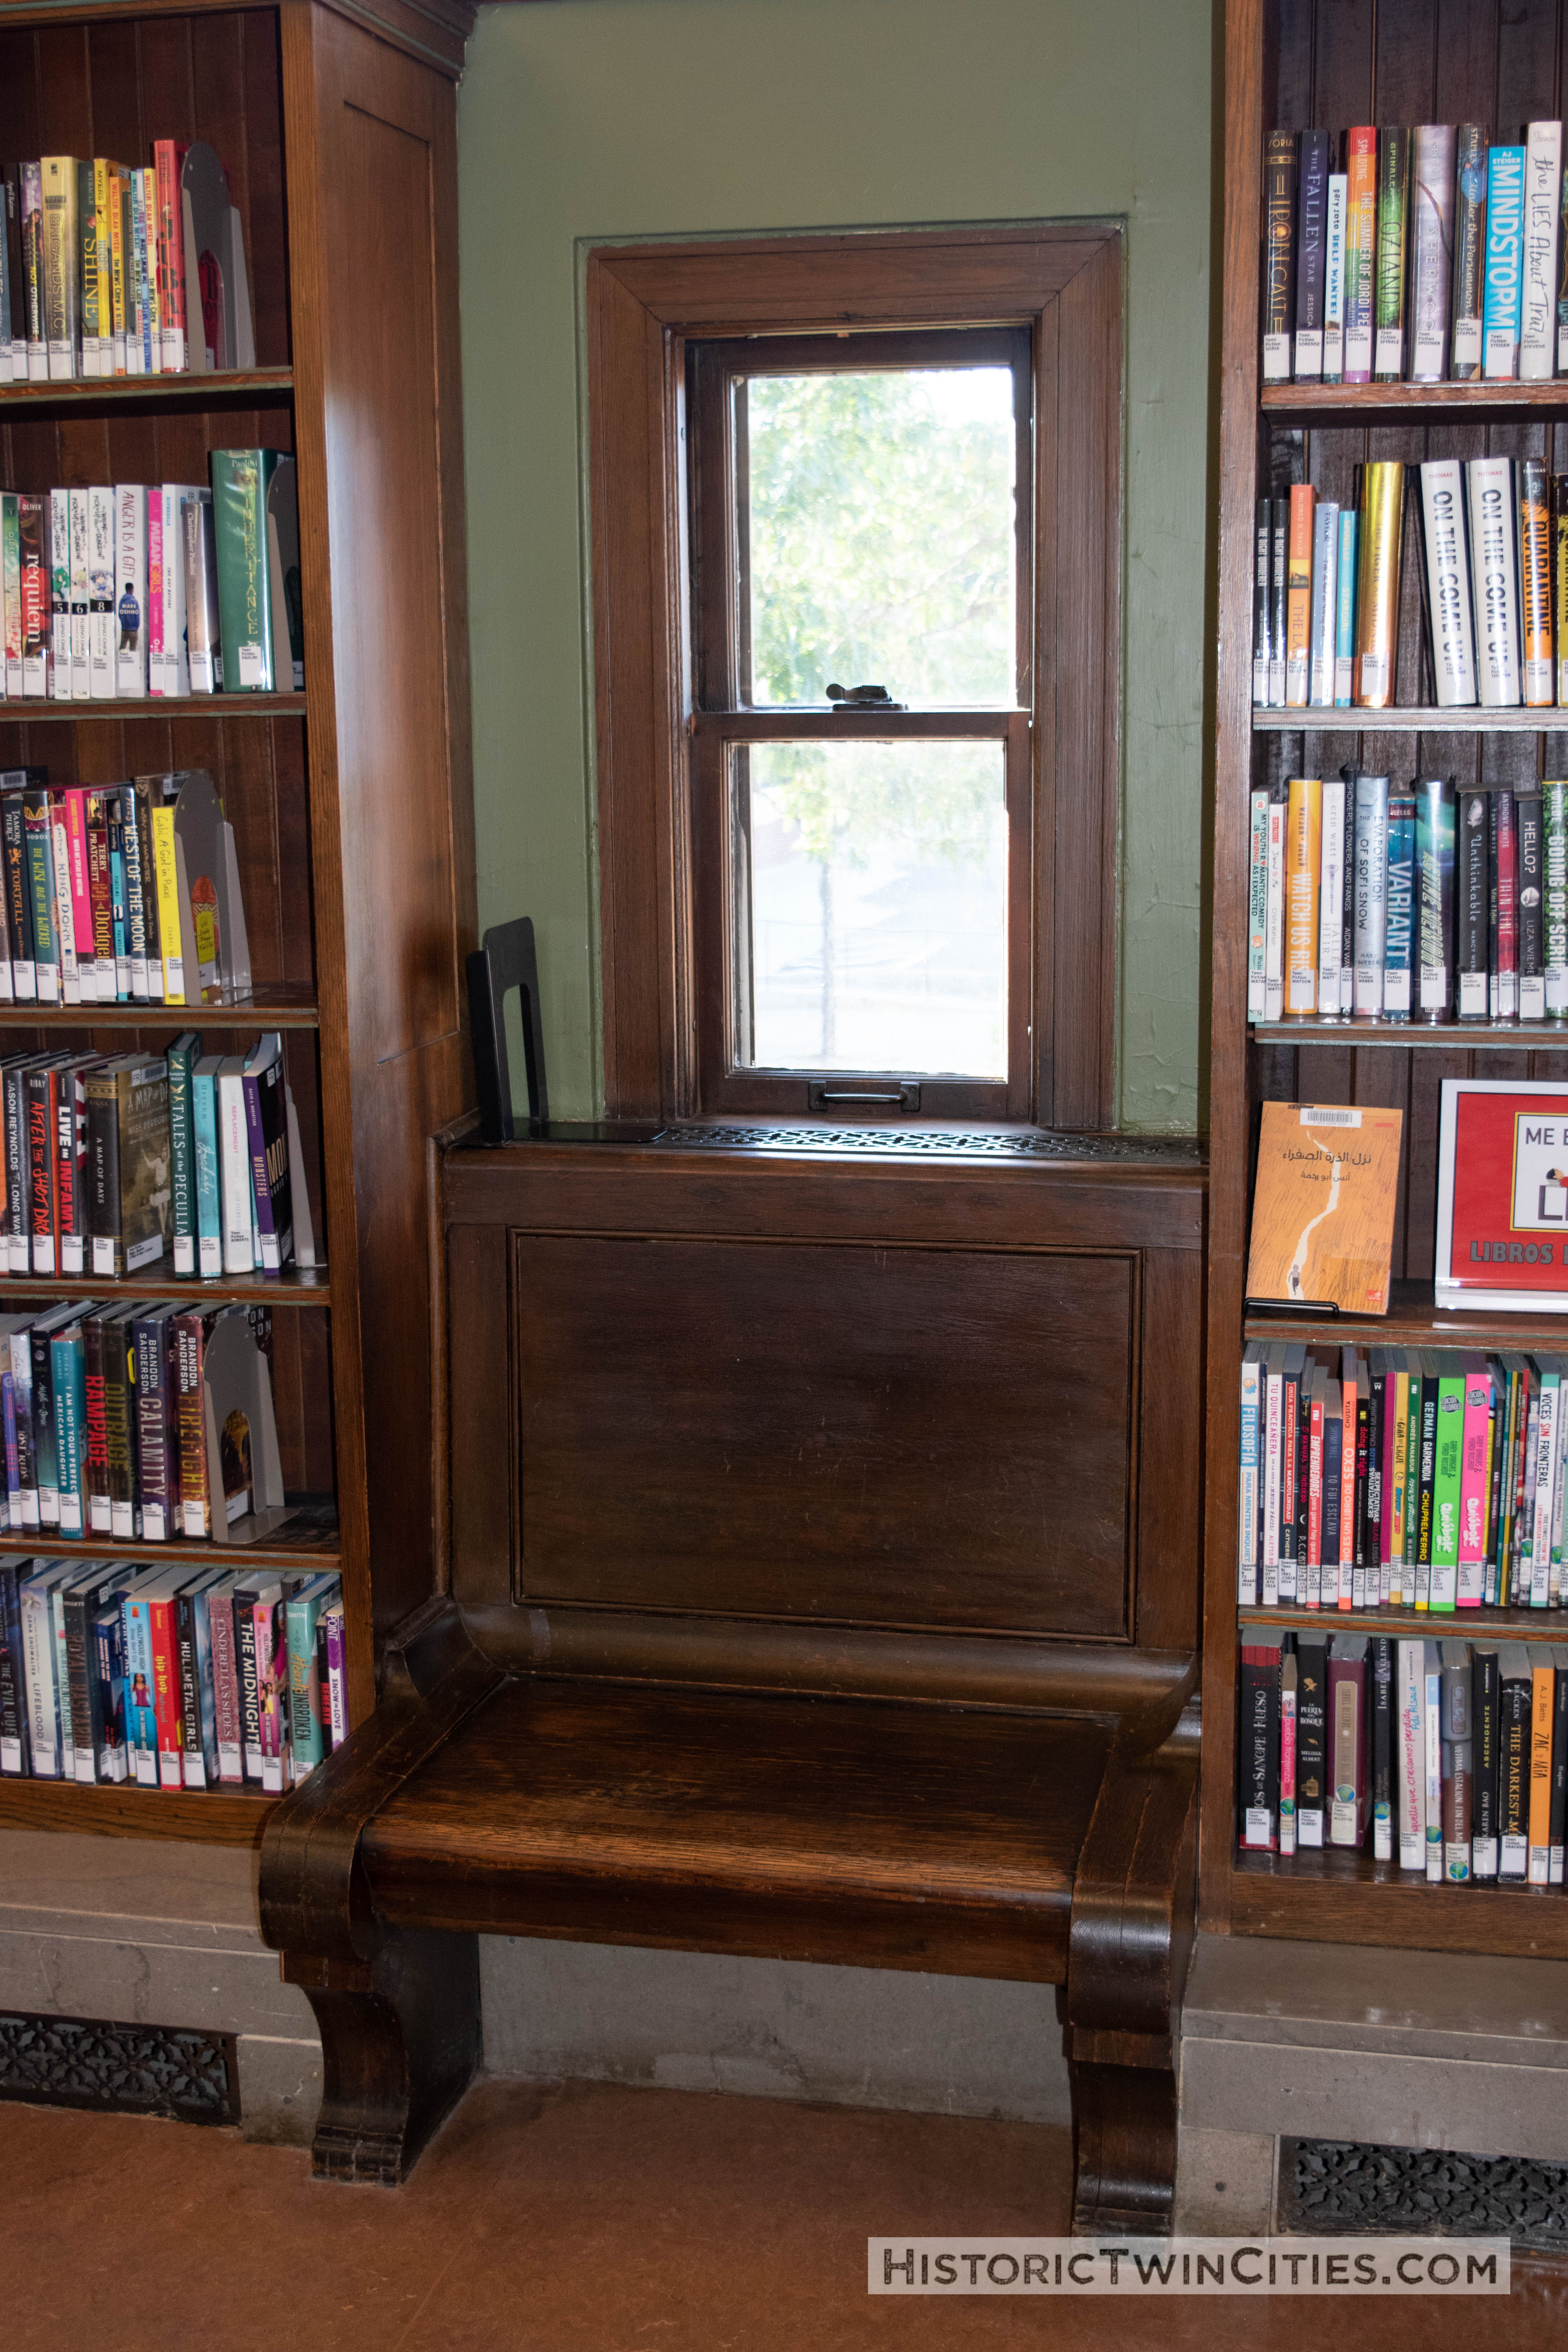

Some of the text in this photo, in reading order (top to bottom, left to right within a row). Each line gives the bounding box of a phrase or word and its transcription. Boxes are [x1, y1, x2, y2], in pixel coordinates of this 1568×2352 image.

[1269, 139, 1293, 148] SORIA
[1357, 140, 1367, 181] SPALDING
[1305, 175, 1320, 253] FALLEN
[1306, 256, 1314, 282] STAR
[1358, 191, 1372, 309] THE SUMMER OF JORDI
[1487, 165, 1520, 332] MINDSTORM
[84, 238, 99, 318] SHINE
[1330, 269, 1339, 316] WANTED
[122, 492, 136, 528] ANGER
[123, 533, 135, 542] IS
[123, 557, 136, 579] GIFT
[1433, 491, 1461, 633] ON THE COME
[1482, 490, 1506, 633] ON THE COME
[24, 554, 40, 643] requiem
[57, 603, 62, 613] 5
[77, 604, 83, 614] 6
[98, 602, 105, 612] 8
[12, 810, 21, 845] TAMORA
[1261, 814, 1266, 825] MY
[1360, 839, 1368, 855] OF
[90, 833, 99, 882] PRATCHETT
[1374, 817, 1383, 902] EVAPORATION
[1524, 822, 1535, 873] HELLO?
[12, 868, 23, 925] TORTALL
[125, 826, 146, 952] WEST OF THE MOON
[1469, 835, 1481, 921] Unthinkable
[1549, 836, 1565, 919] GOING OFF
[94, 911, 111, 958] Dodger
[1290, 873, 1312, 945] WATCH US
[1359, 891, 1367, 930] SNOW
[1386, 861, 1411, 961] VARIANT
[1499, 879, 1512, 935] THIN LINE
[7, 1080, 19, 1170] JASON REYNOLDS
[172, 1105, 185, 1149] TALES
[1526, 1128, 1554, 1145] ME
[30, 1101, 49, 1208] AFTER THE SHOT
[58, 1107, 74, 1233] LIVE IN INFAMY
[98, 1168, 104, 1179] OF
[254, 1157, 267, 1196] MONSTERS
[1283, 1149, 1371, 1166] نزل الذرة الصفراء
[1321, 1171, 1332, 1181] أبو
[1332, 1172, 1350, 1182] أنس
[11, 1184, 21, 1235] LONG WAY
[1470, 1241, 1553, 1265] LIBROS
[139, 1333, 149, 1394] SANDERSON
[149, 1340, 158, 1387] BRANDON
[180, 1330, 189, 1392] SANDERSON
[188, 1338, 198, 1386] BRANDON
[85, 1376, 108, 1466] RAMPAGE
[105, 1384, 128, 1469] OUTRAGE
[140, 1398, 165, 1495] CALAMITY
[179, 1396, 205, 1496] FIREFIGHT
[1241, 1407, 1257, 1464] FILOSOFÍA
[1269, 1384, 1279, 1455] TU QUINCEAÑERA
[1358, 1427, 1368, 1448] doing
[1421, 1402, 1433, 1481] GERMAN GARMENDIA
[1537, 1393, 1551, 1487] VOCES SIN FRONTERAS
[1310, 1436, 1320, 1497] EMPRENDEDORES
[1358, 1458, 1368, 1477] right
[1343, 1448, 1354, 1561] NO ES UN LIBRO DE SEXO
[1420, 1490, 1429, 1560] #CHUPAELPERRO
[33, 1683, 44, 1738] LIFEBLOOD
[181, 1642, 196, 1751] HULLMETAL GIRLS
[241, 1623, 260, 1743] THE MIDNIGHT
[1254, 1690, 1266, 1728] HUESO
[294, 1689, 311, 1740] UNBROKEN
[1285, 1719, 1294, 1744] pueblo
[1300, 1717, 1323, 1727] BOSQUE
[1509, 1726, 1521, 1817] THE DARKEST
